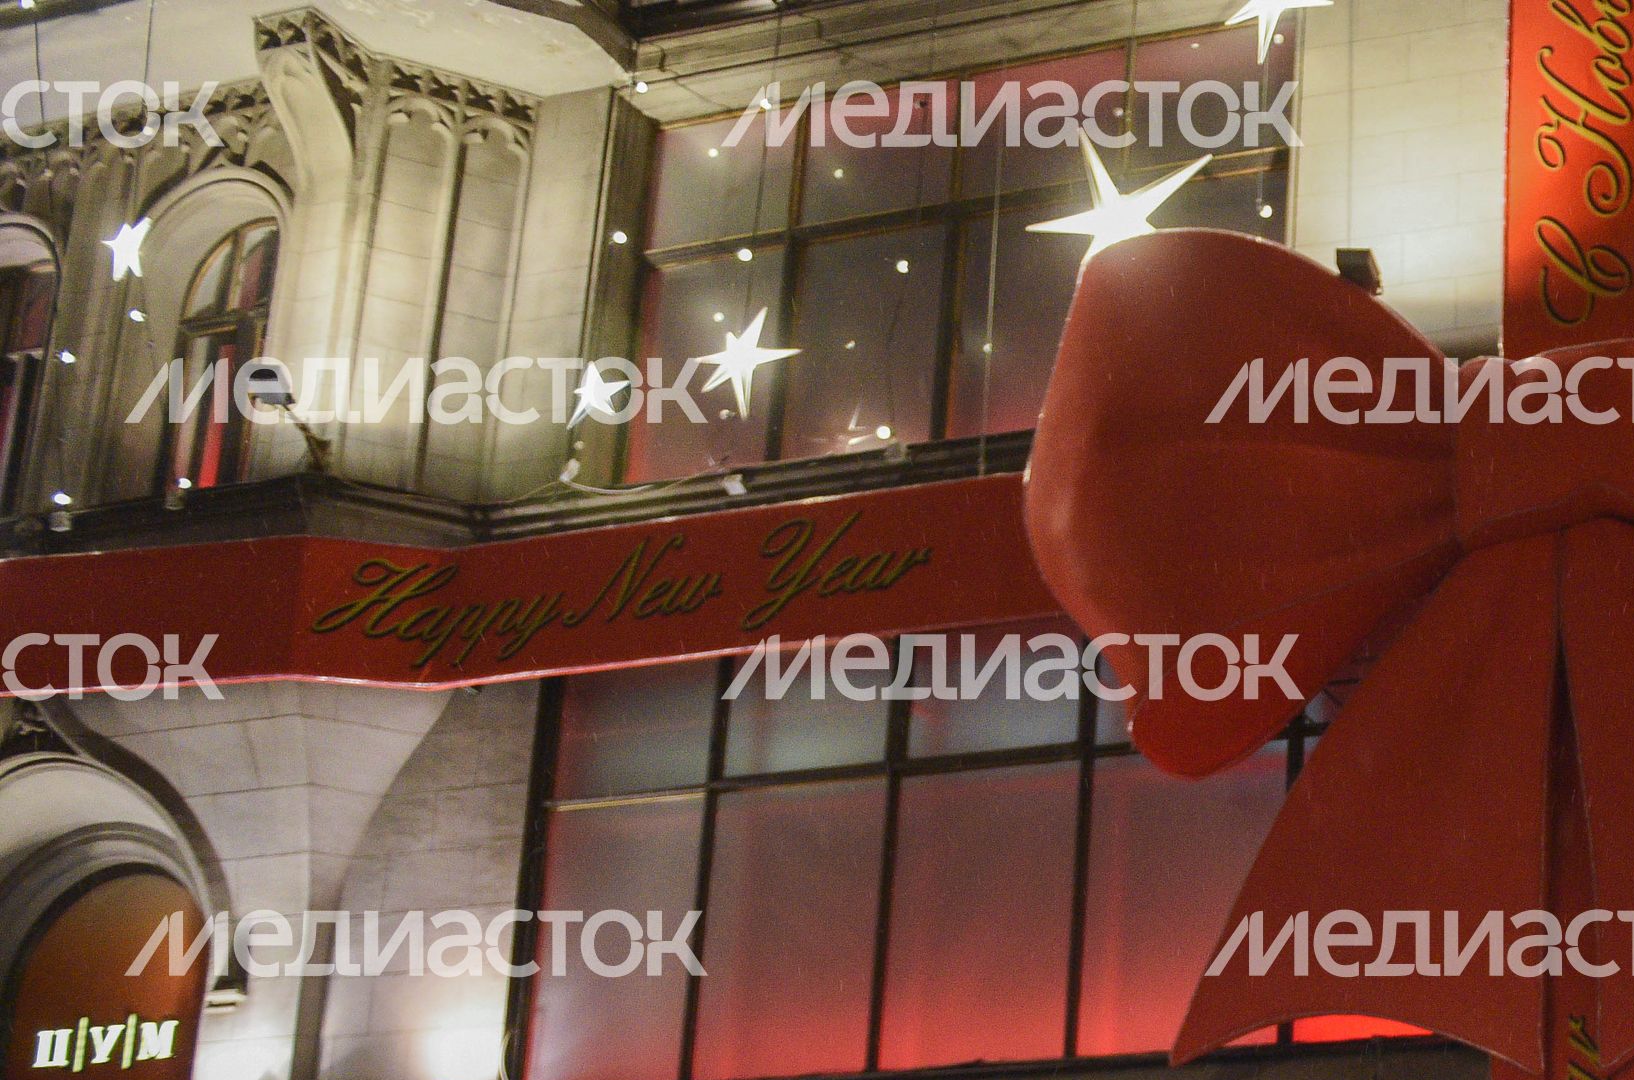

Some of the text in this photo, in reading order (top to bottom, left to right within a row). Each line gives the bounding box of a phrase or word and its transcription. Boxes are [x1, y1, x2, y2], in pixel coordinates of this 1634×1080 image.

[311, 511, 932, 668] Happy New Year
